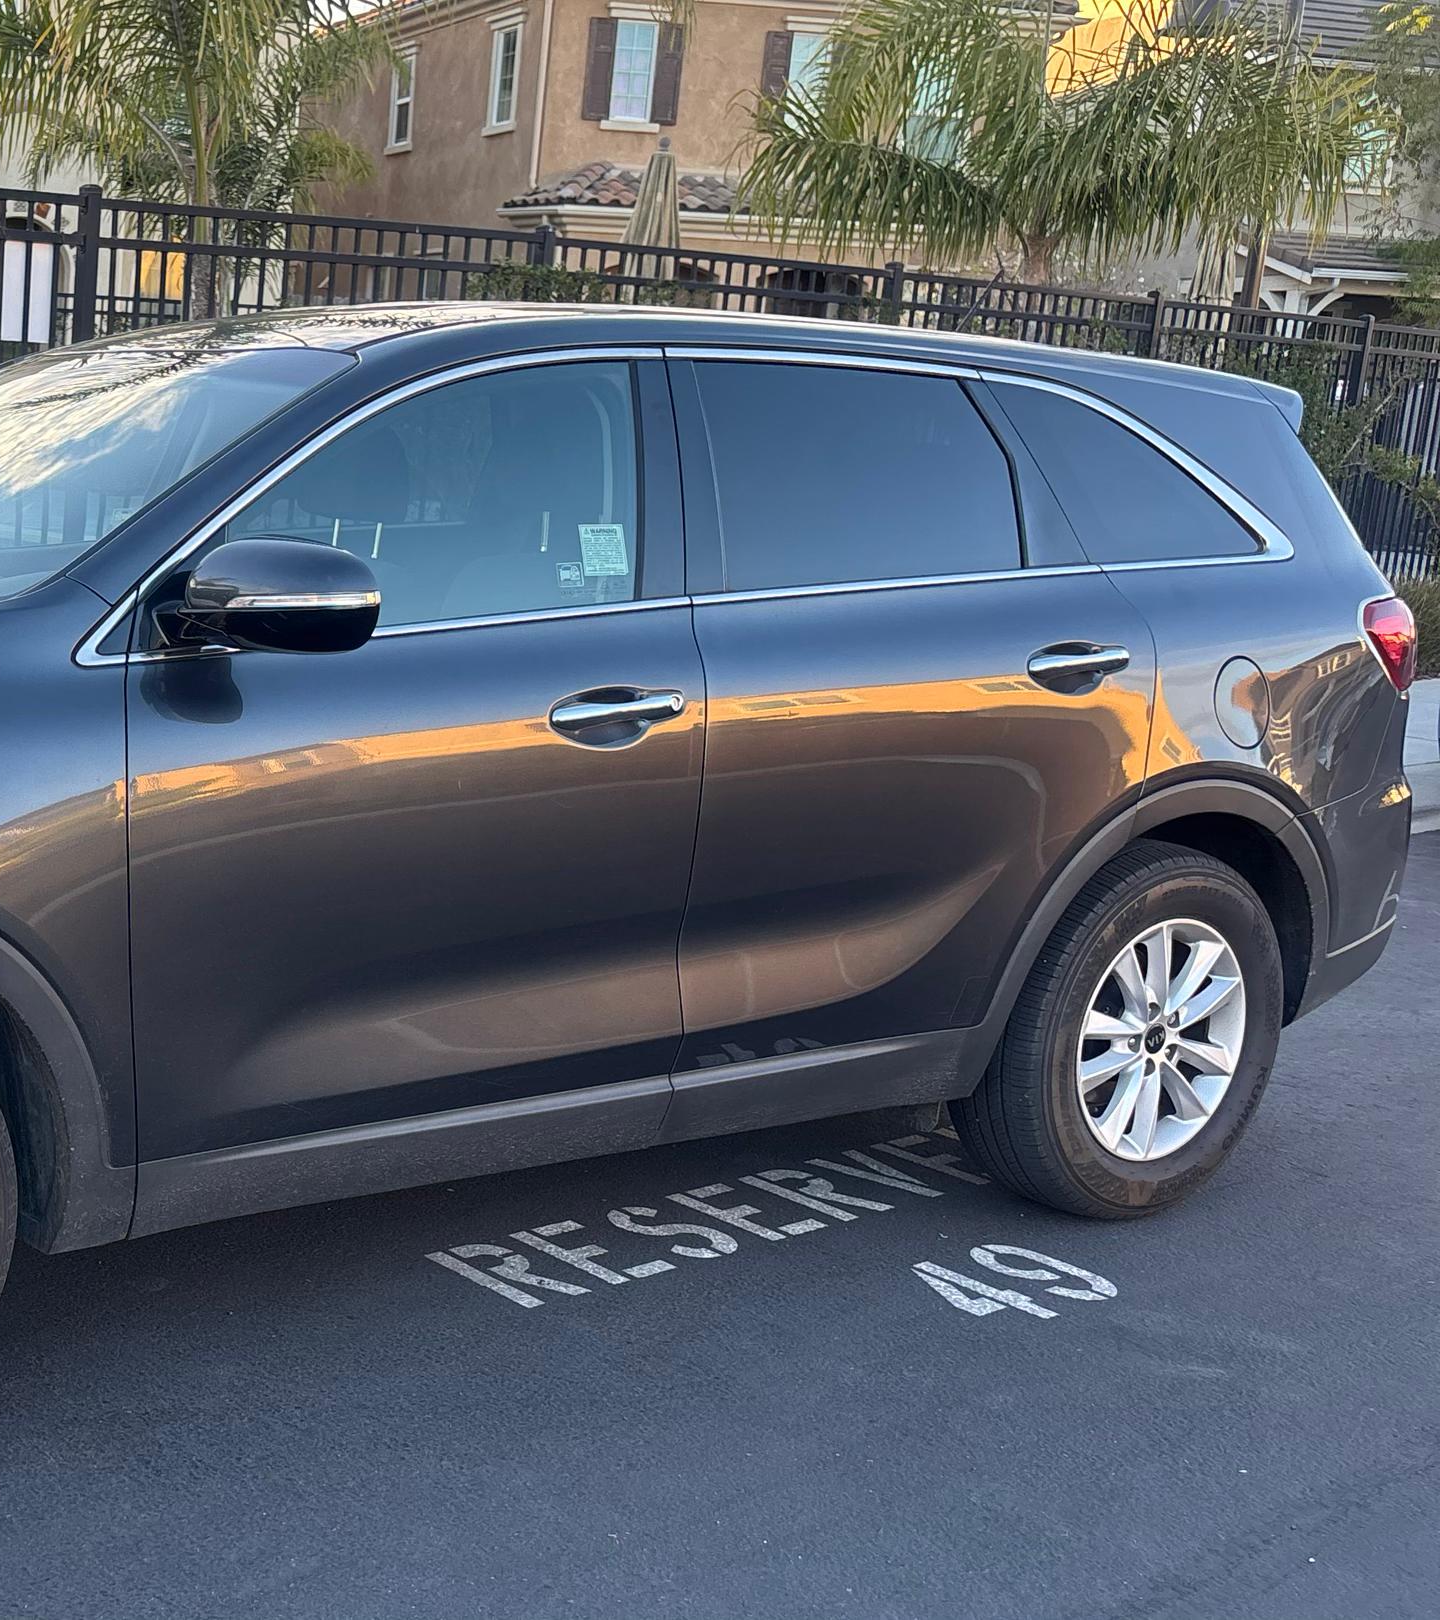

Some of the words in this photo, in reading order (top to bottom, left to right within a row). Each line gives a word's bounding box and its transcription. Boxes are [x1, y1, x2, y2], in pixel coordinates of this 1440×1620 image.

[1147, 1030, 1165, 1047] KIA
[1222, 1066, 1268, 1151] KUMHO
[423, 1126, 992, 1309] RESERVE
[911, 1244, 1118, 1320] 49
